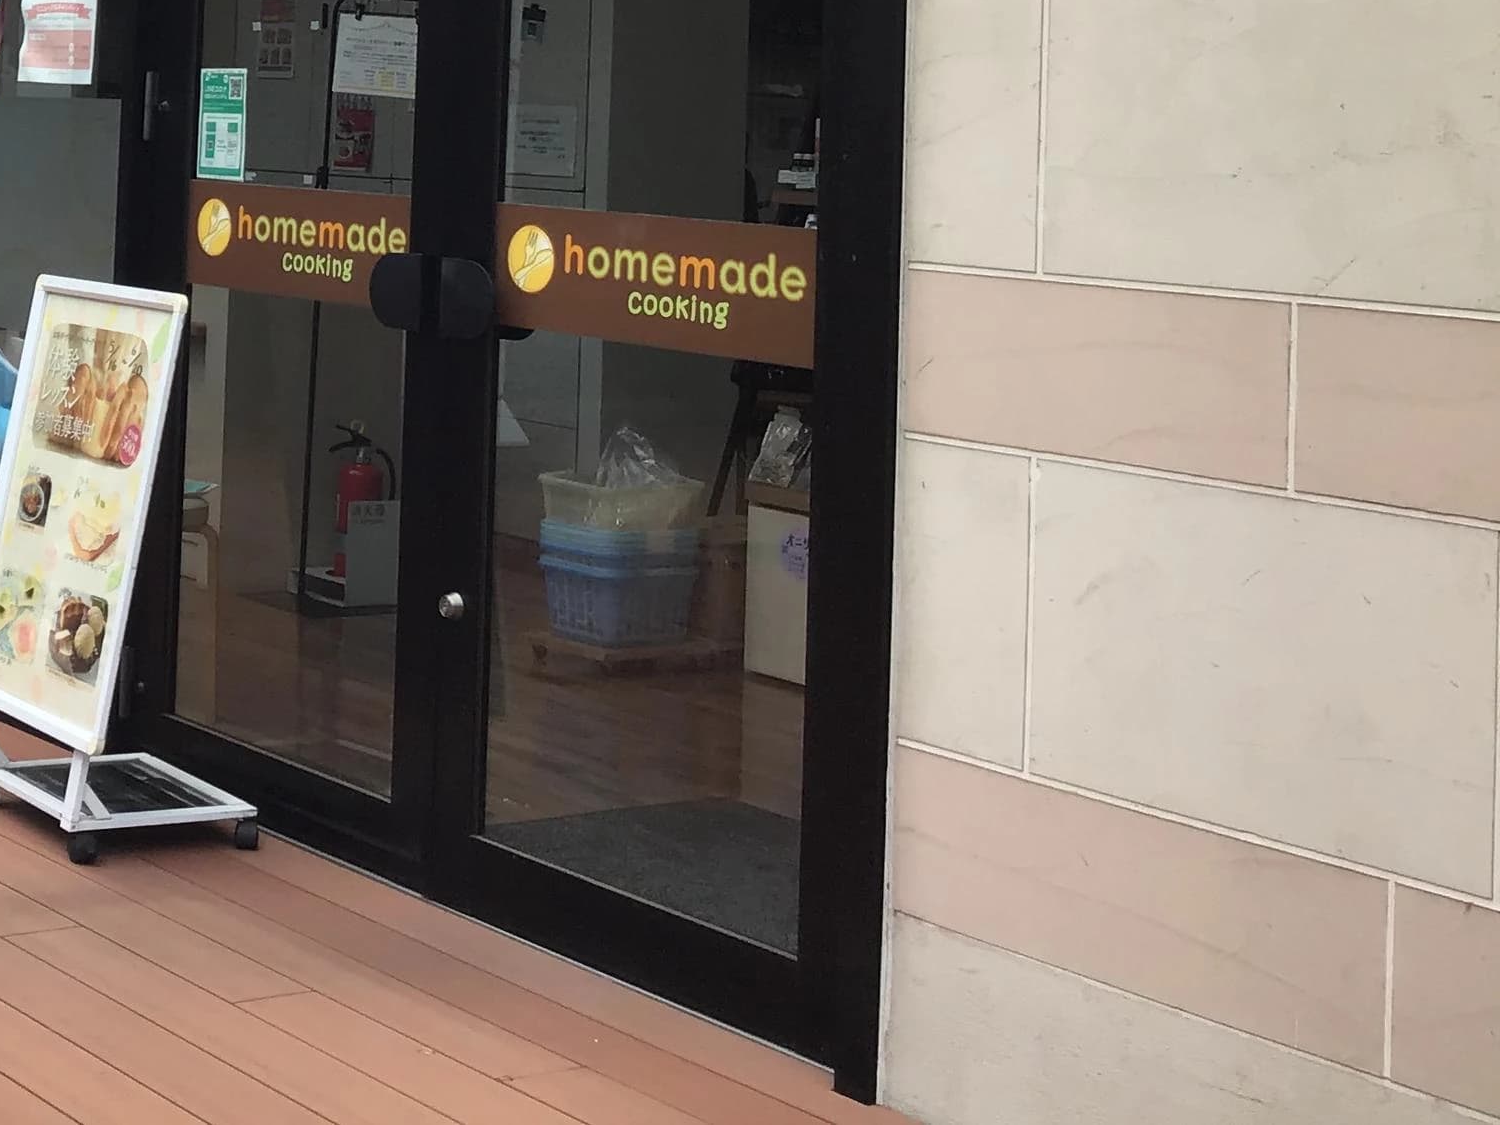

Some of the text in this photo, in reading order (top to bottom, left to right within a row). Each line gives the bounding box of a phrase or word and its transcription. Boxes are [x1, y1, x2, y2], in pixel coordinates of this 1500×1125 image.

[238, 205, 406, 255] homemade
[282, 251, 353, 282] cooking
[564, 234, 807, 301] homemade
[628, 291, 730, 329] cooking
[51, 346, 80, 381] 体験
[41, 383, 81, 409] レッスン
